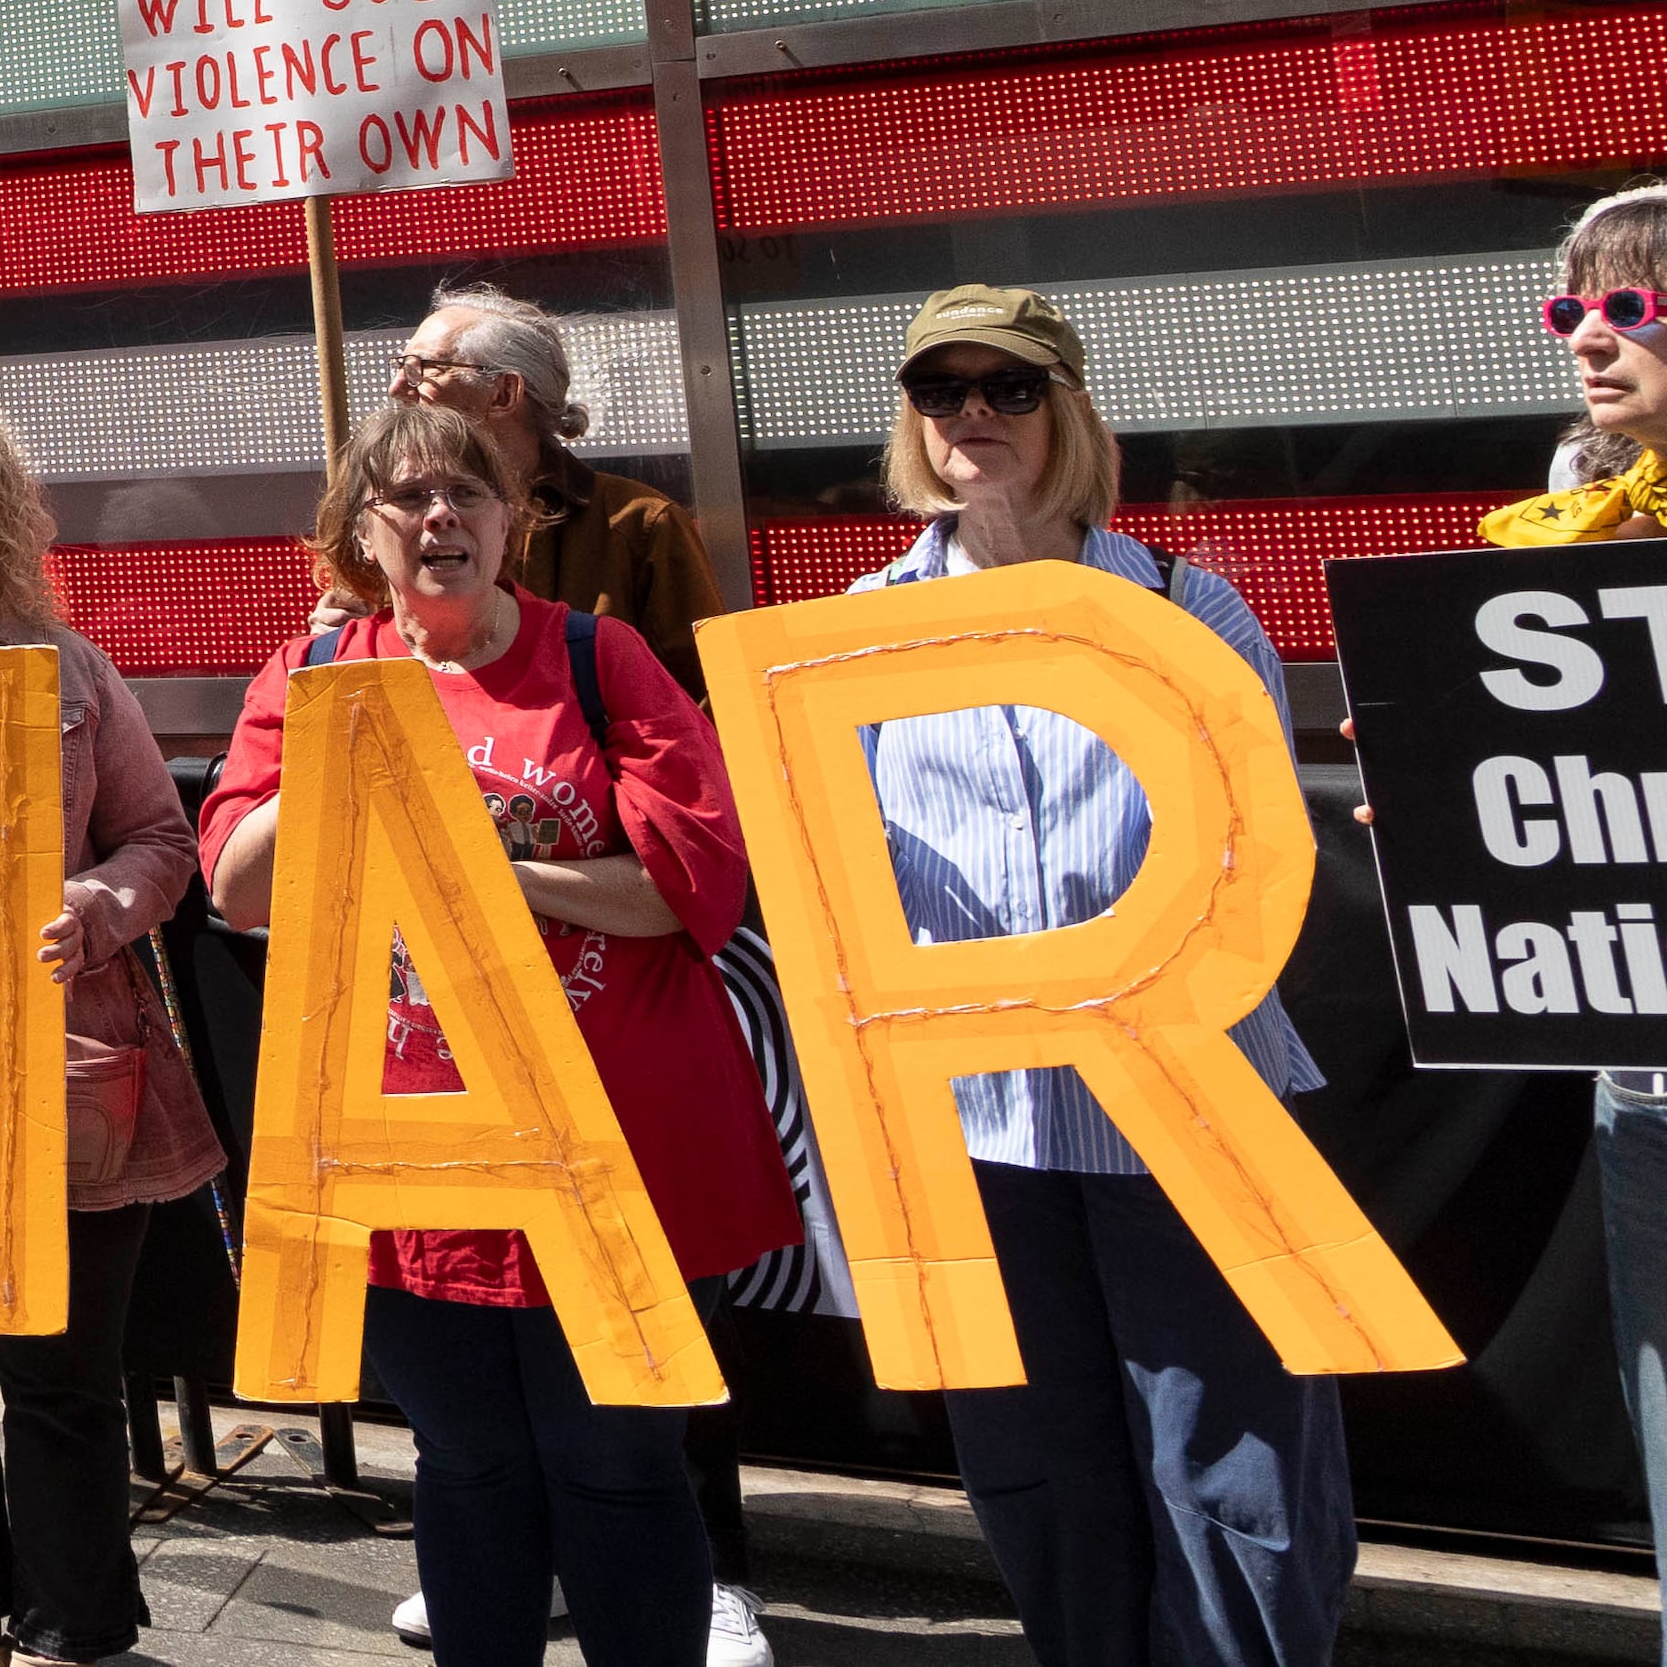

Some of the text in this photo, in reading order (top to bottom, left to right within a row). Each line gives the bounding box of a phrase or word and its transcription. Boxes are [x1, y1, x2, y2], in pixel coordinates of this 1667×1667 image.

[126, 12, 496, 120] VIOLENCE ON
[154, 98, 500, 196] THEIR OWN
[1407, 902, 1667, 1015] Nati
